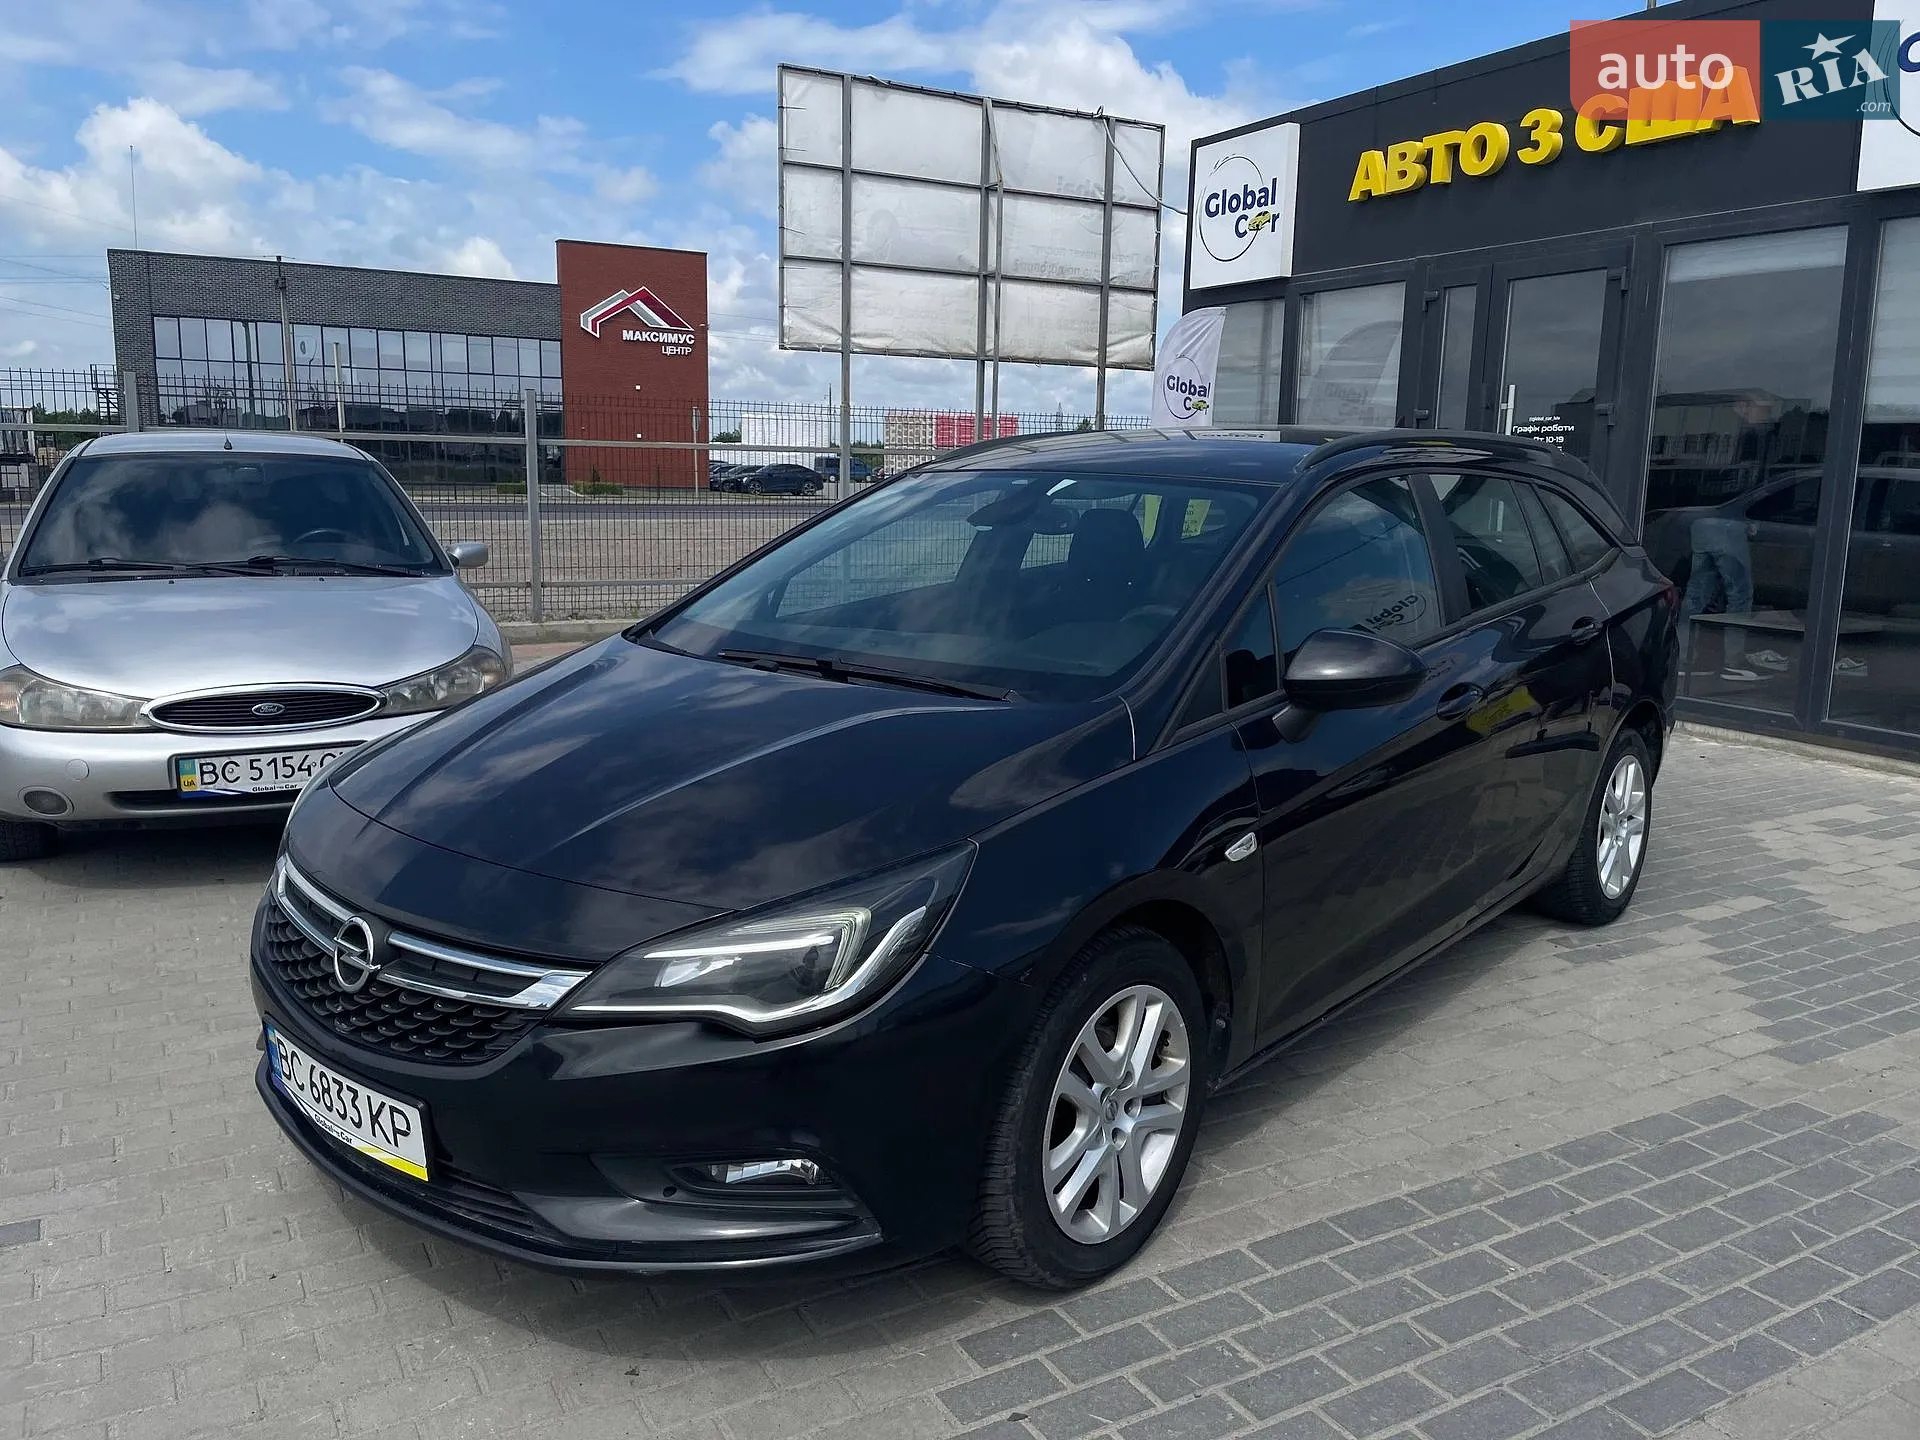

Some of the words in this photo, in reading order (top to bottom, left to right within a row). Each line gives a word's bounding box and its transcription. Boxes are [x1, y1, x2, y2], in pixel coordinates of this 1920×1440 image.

[1348, 122, 1510, 201] АВТО
[1574, 66, 1760, 152] США
[1205, 178, 1277, 218] Global
[622, 330, 695, 344] МАКСИМУС
[662, 346, 692, 356] ЦЕНТР
[1166, 375, 1211, 398] Global
[1541, 424, 1574, 433] роботи
[199, 761, 241, 786] BC
[249, 754, 312, 782] 5154
[277, 1036, 305, 1092] BC
[309, 1064, 363, 1129] 6833
[366, 1094, 412, 1148] KP
